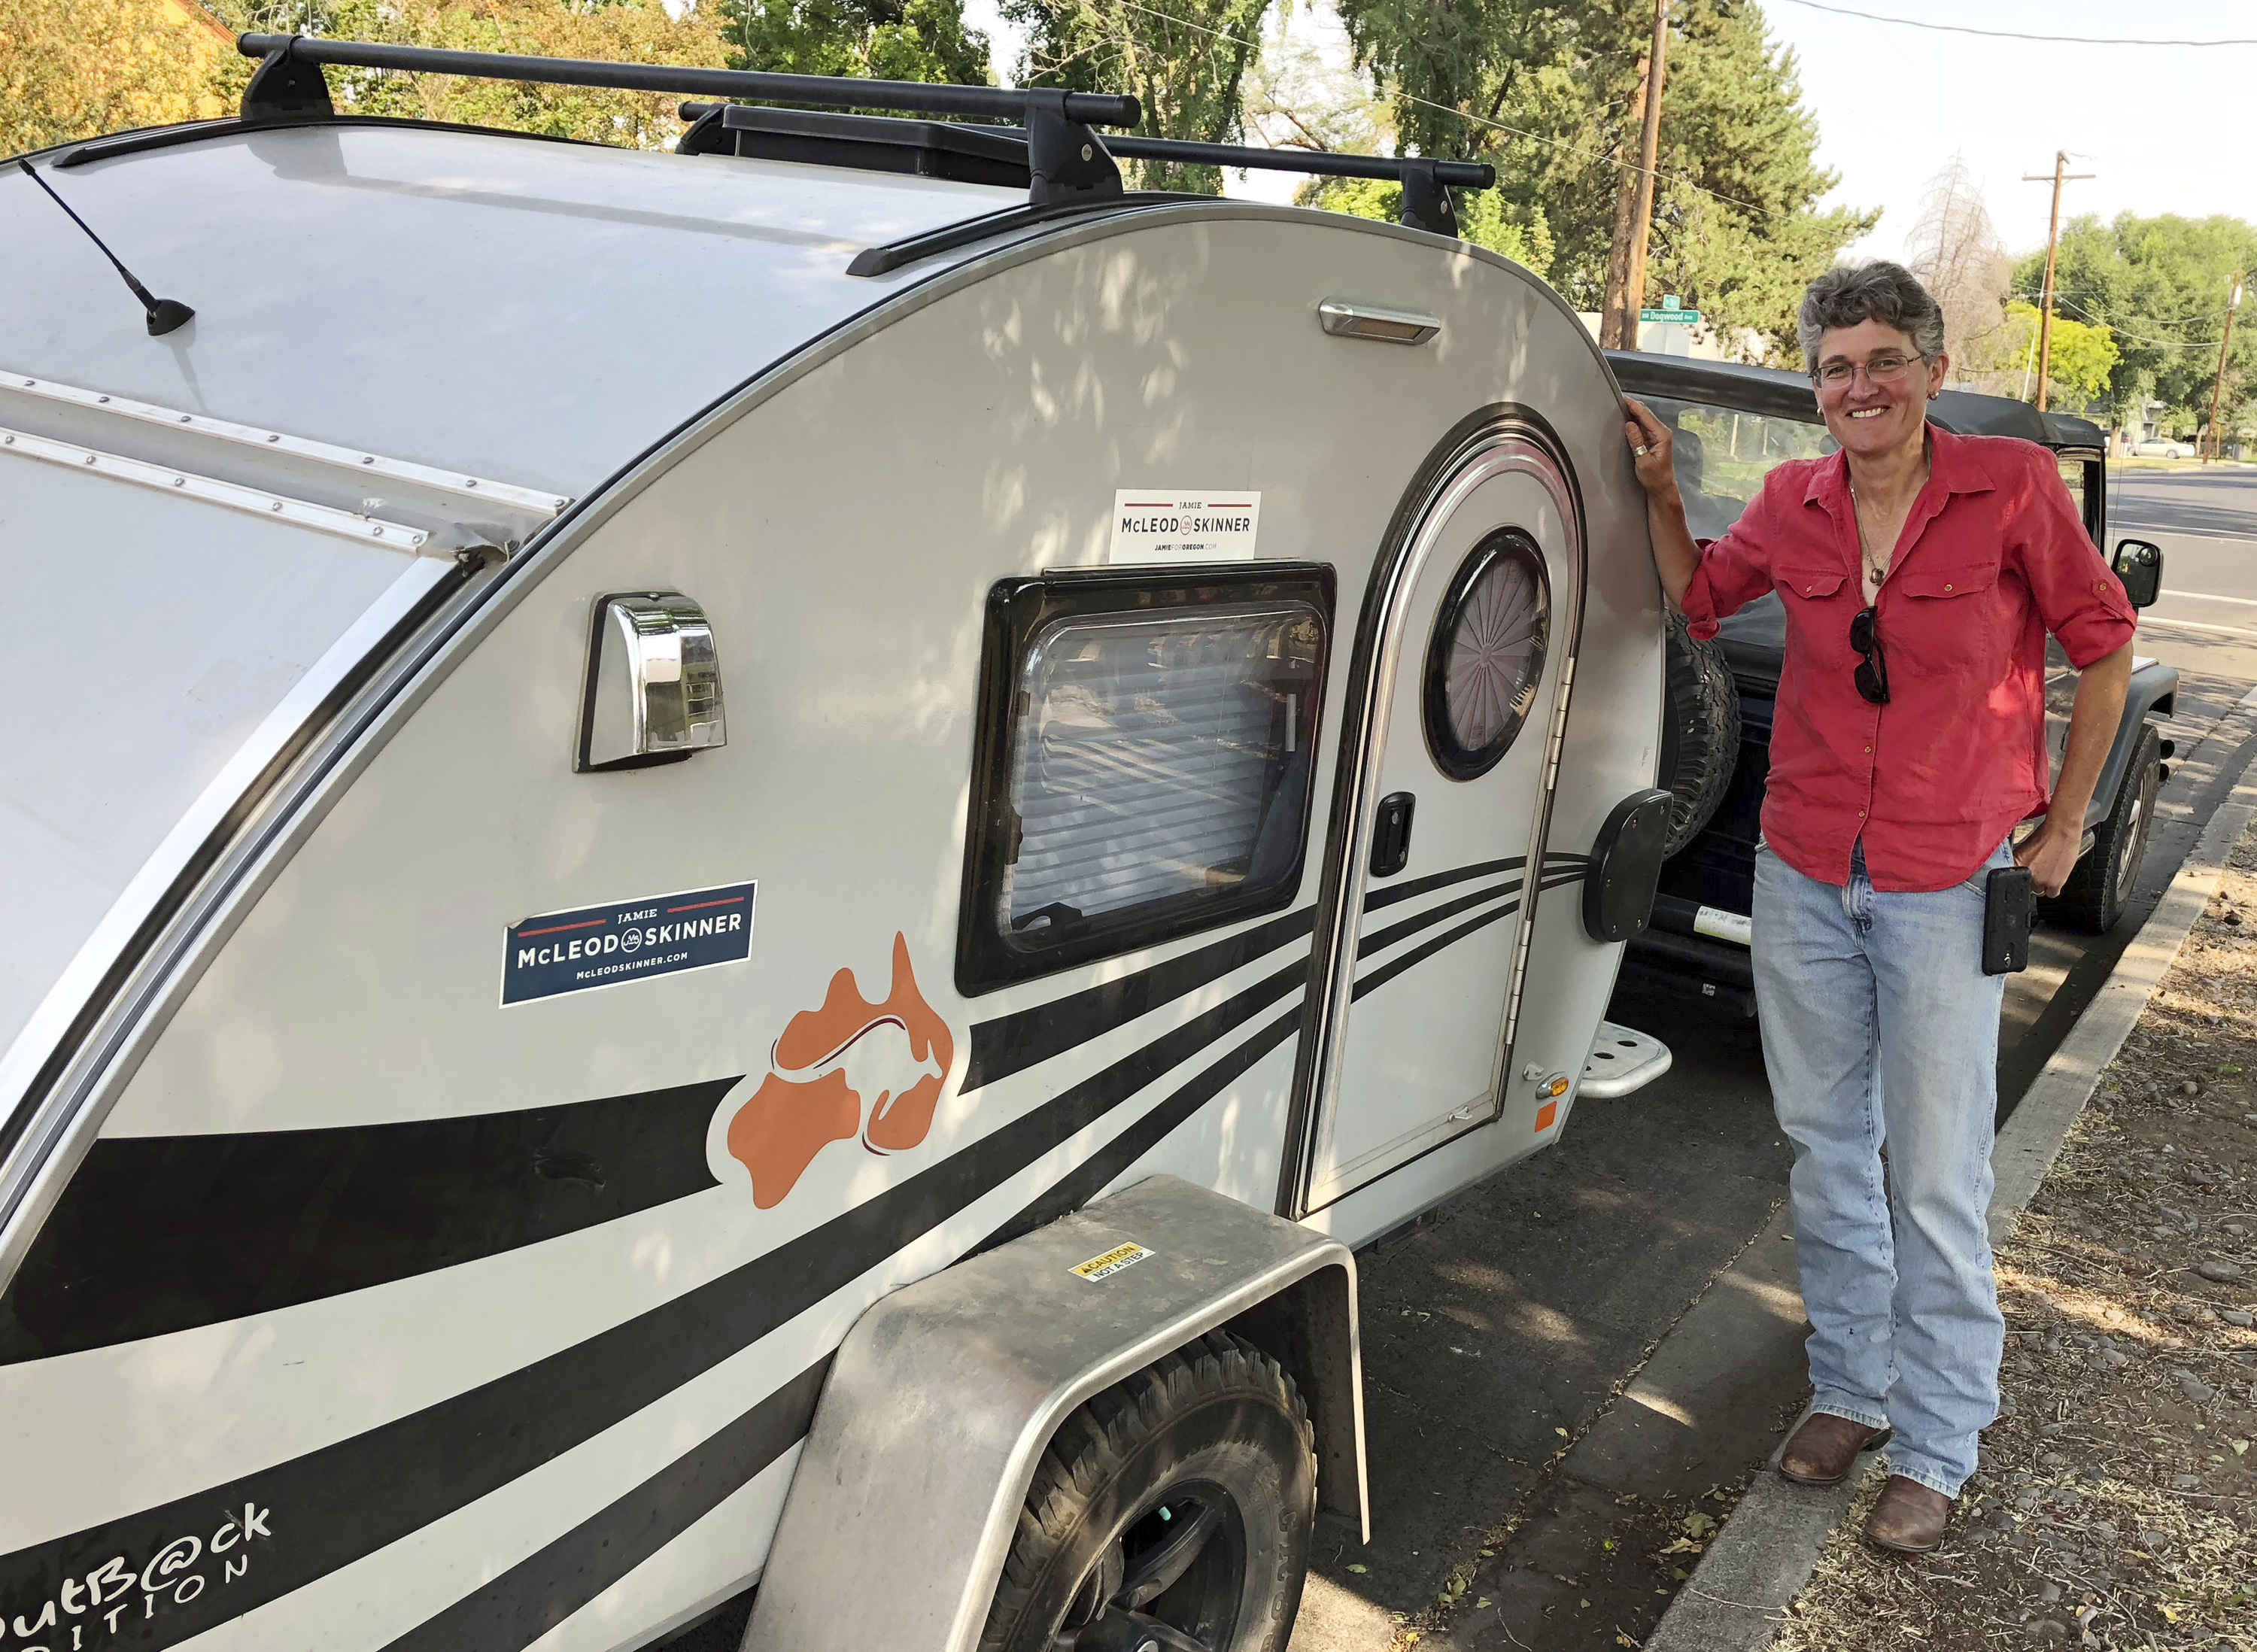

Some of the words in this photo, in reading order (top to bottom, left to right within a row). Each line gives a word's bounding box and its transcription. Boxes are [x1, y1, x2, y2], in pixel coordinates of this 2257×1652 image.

[1650, 311, 1684, 322] Dogwood
[1193, 518, 1250, 532] SKINNER
[617, 908, 658, 925] JAMIE
[645, 913, 742, 946] SKINNER
[1087, 1246, 1135, 1270] CAUTION
[1092, 1266, 1114, 1278] NOT
[1120, 1252, 1144, 1265] STEP
[0, 1502, 272, 1638] utB@ck
[21, 1554, 248, 1652] ITION
